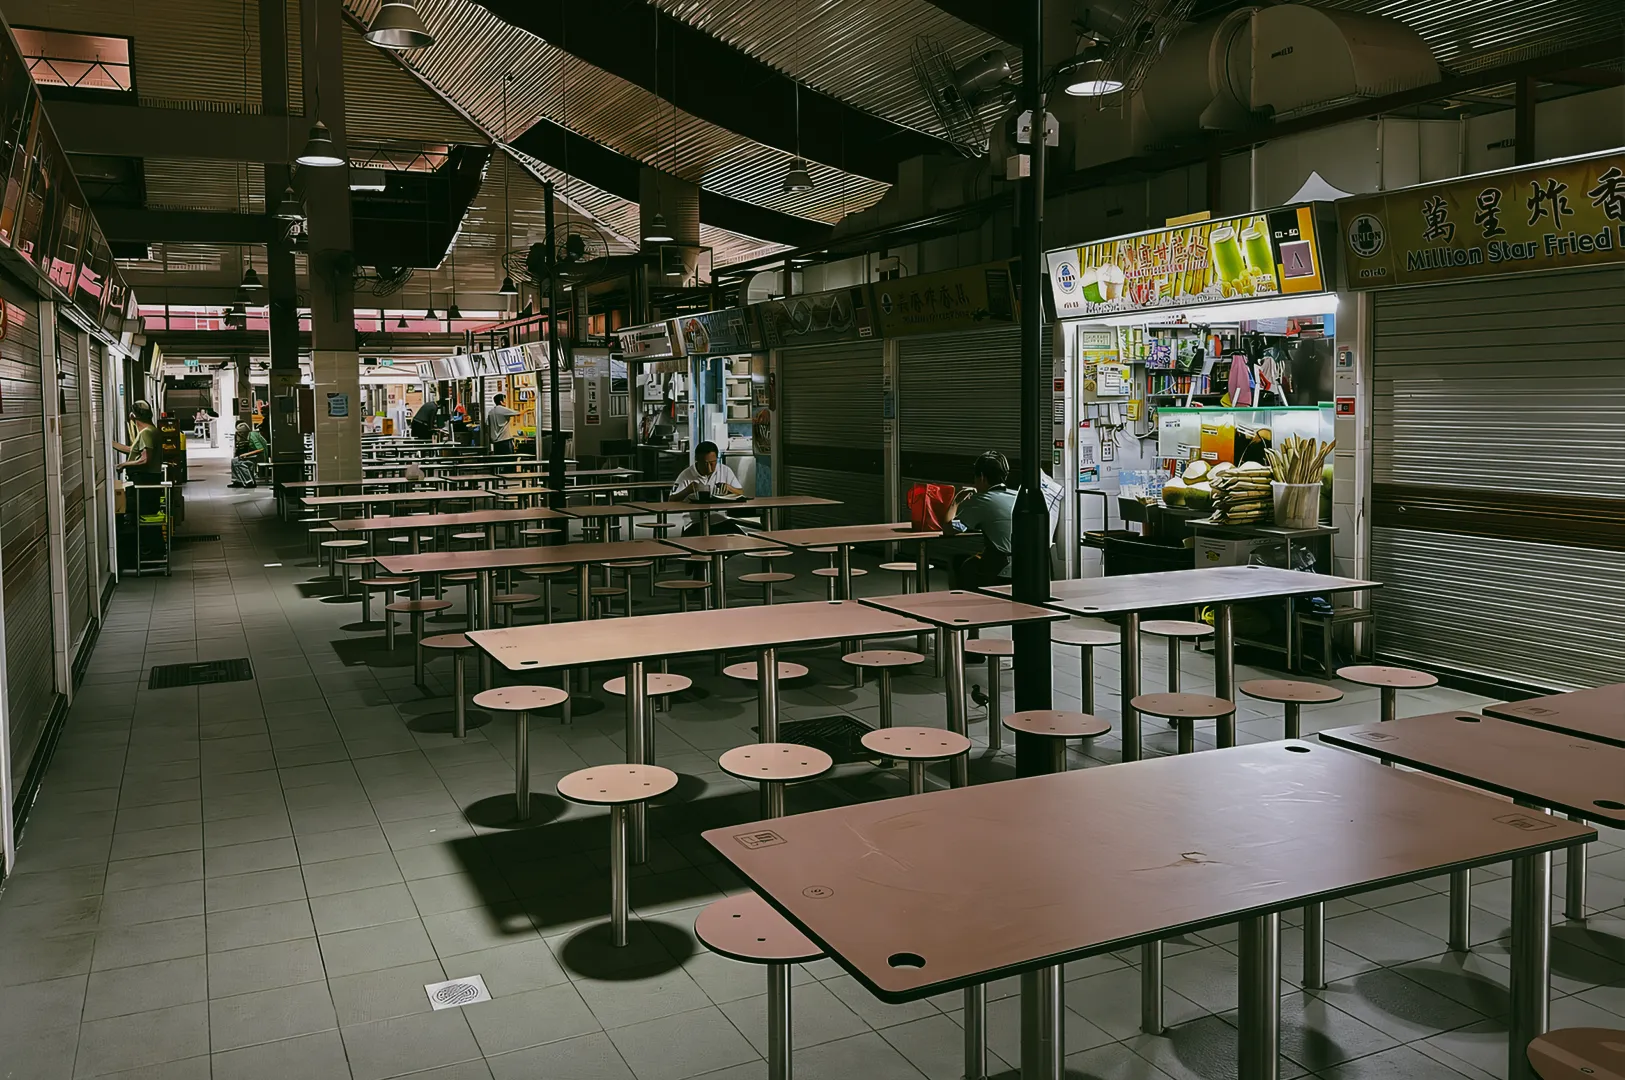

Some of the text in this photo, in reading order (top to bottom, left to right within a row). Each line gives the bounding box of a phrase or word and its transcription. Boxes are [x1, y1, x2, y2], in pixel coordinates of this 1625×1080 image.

[1407, 248, 1483, 272] Million
[1488, 241, 1538, 263] Star
[1543, 225, 1613, 257] Fried
